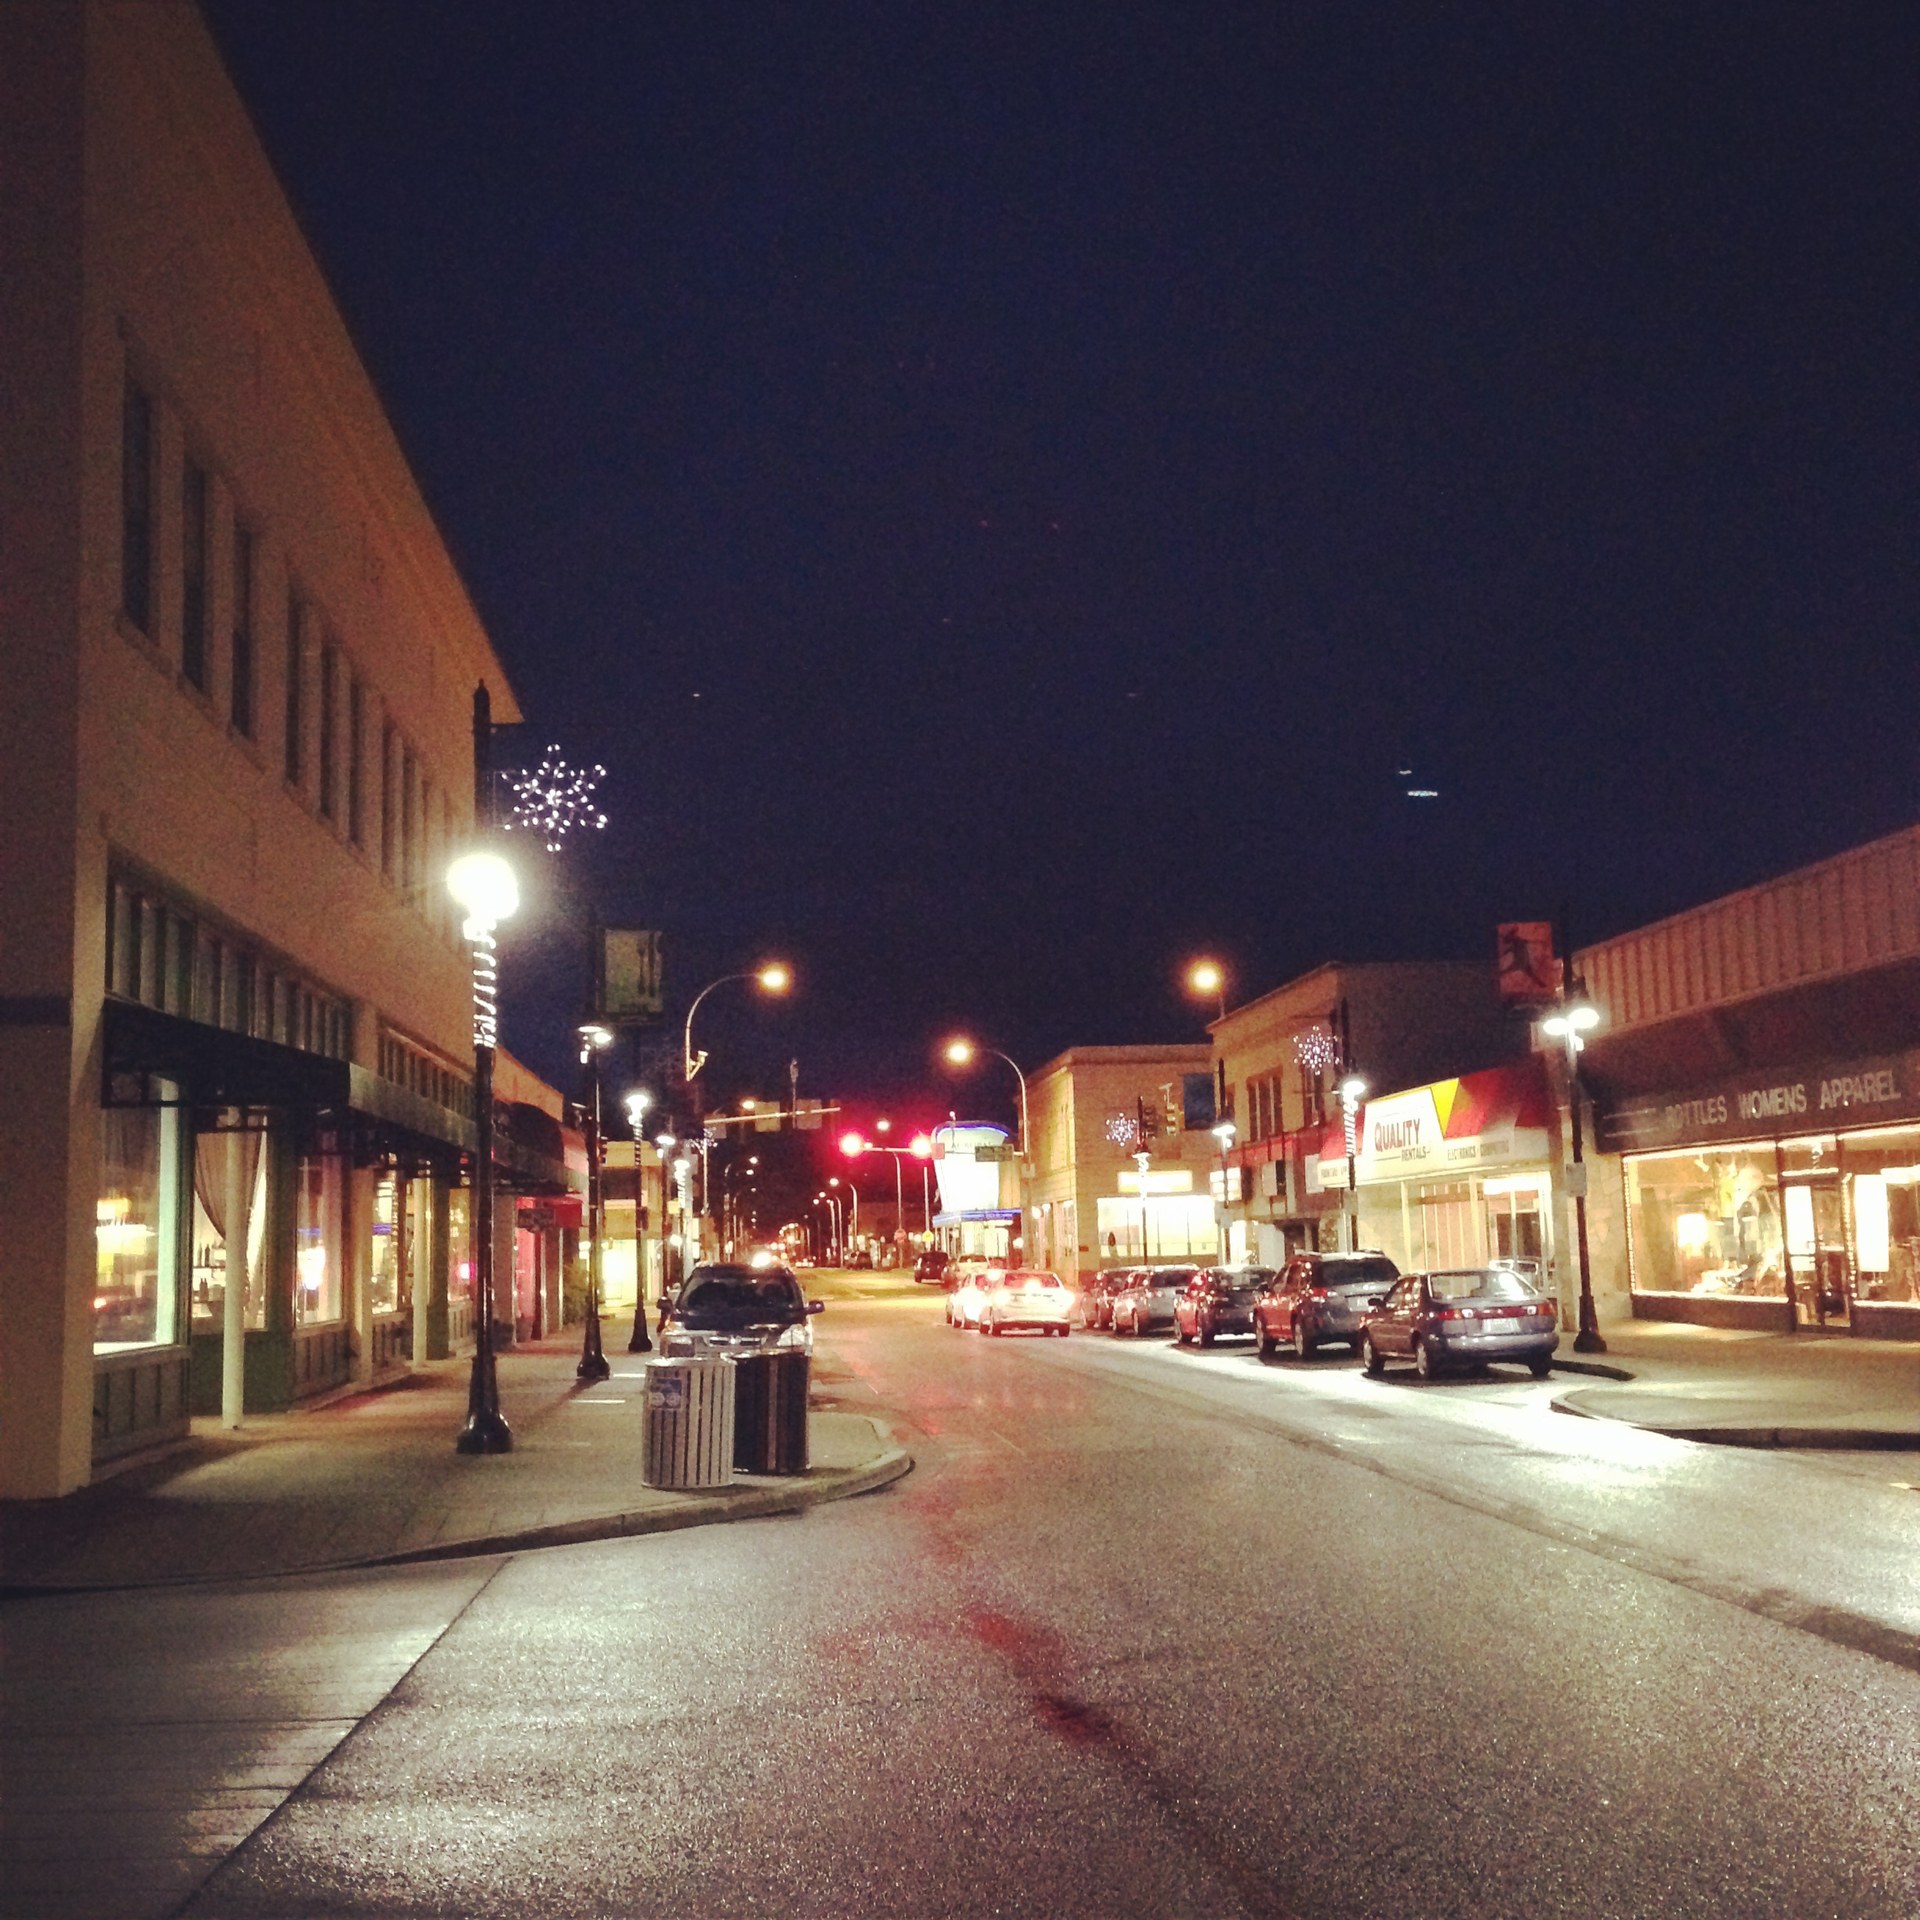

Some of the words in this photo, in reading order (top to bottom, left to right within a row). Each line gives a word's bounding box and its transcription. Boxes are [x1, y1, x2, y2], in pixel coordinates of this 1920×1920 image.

[1738, 1083, 1808, 1120] WOMENS
[1819, 1069, 1902, 1110] APPAREL
[1374, 1118, 1421, 1152] QUALITY
[1401, 1146, 1427, 1162] RENTALS
